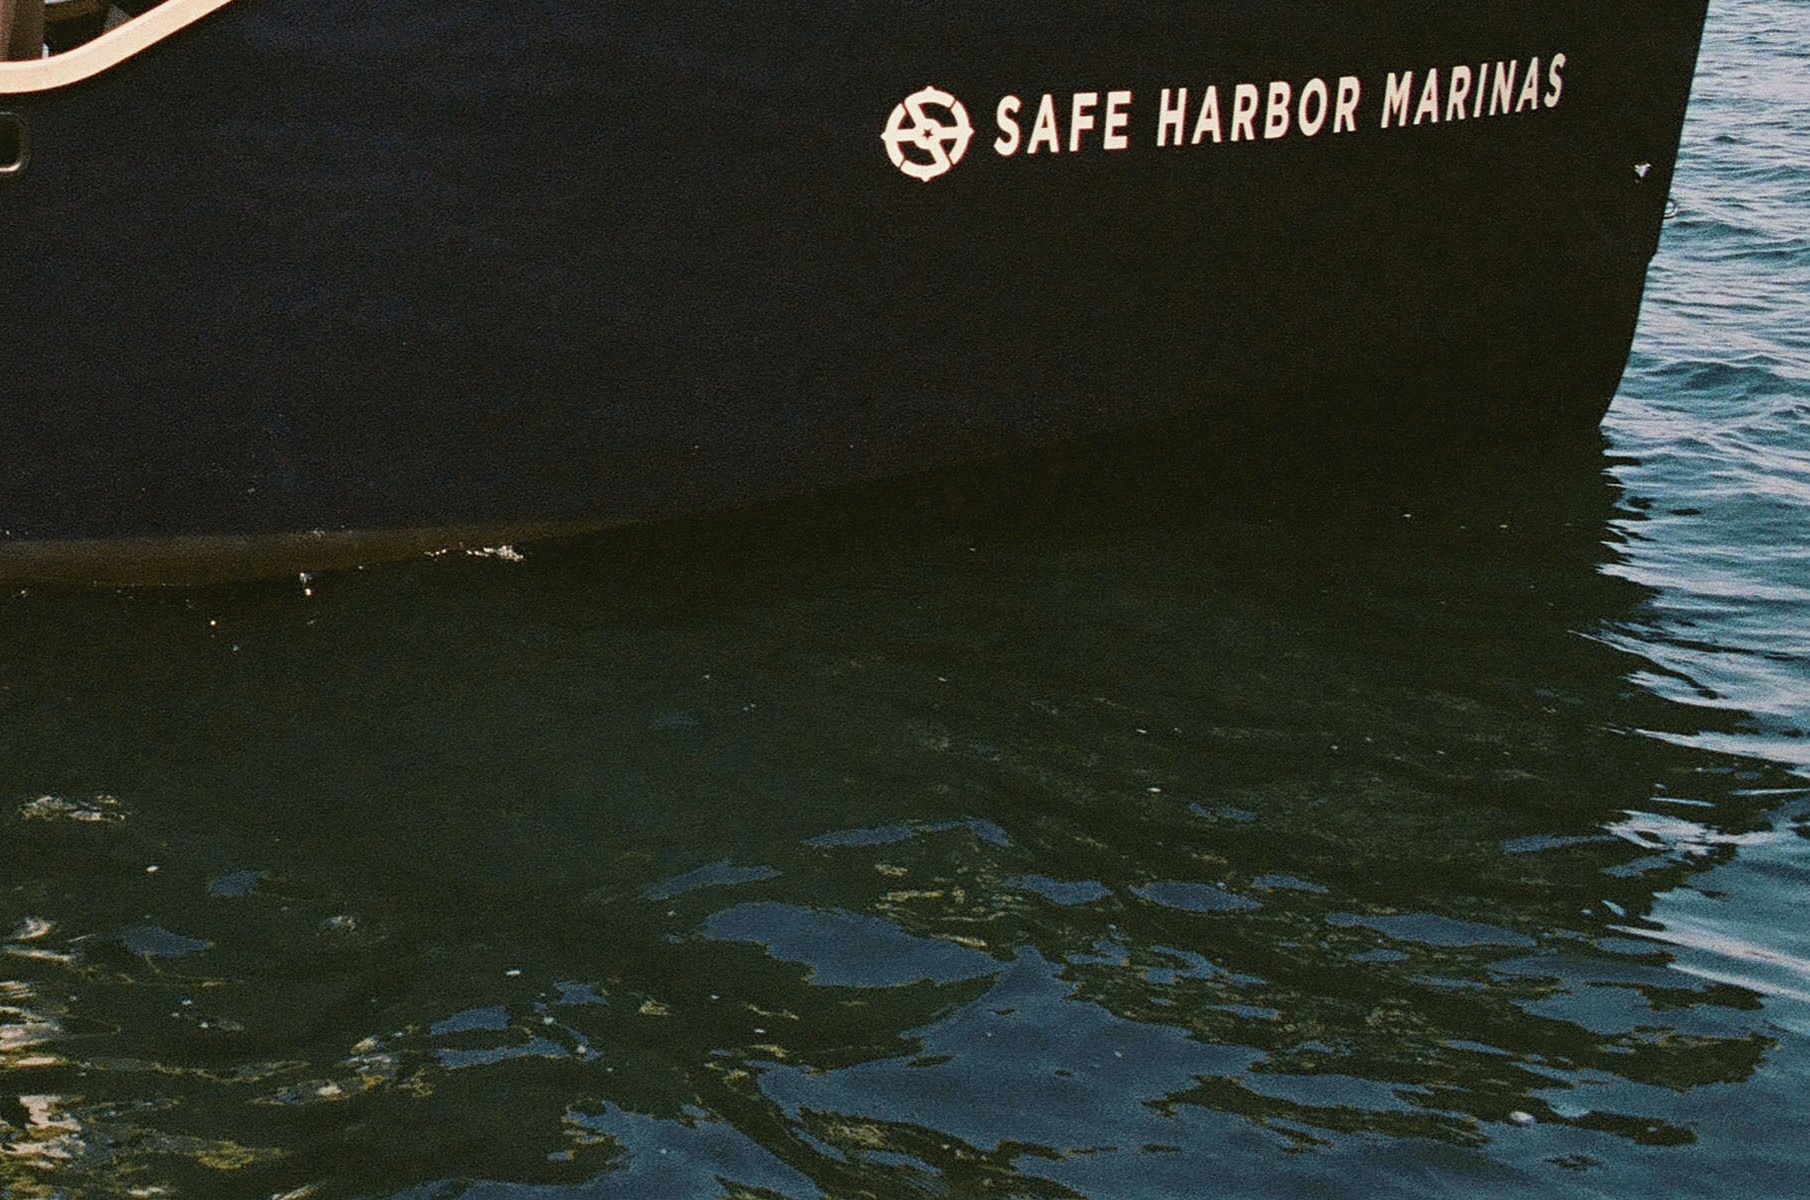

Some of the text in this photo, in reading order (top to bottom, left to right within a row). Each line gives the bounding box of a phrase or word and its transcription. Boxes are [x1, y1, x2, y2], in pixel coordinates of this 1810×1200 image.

[993, 52, 1566, 157] SAFE HARBOR MARINAS
